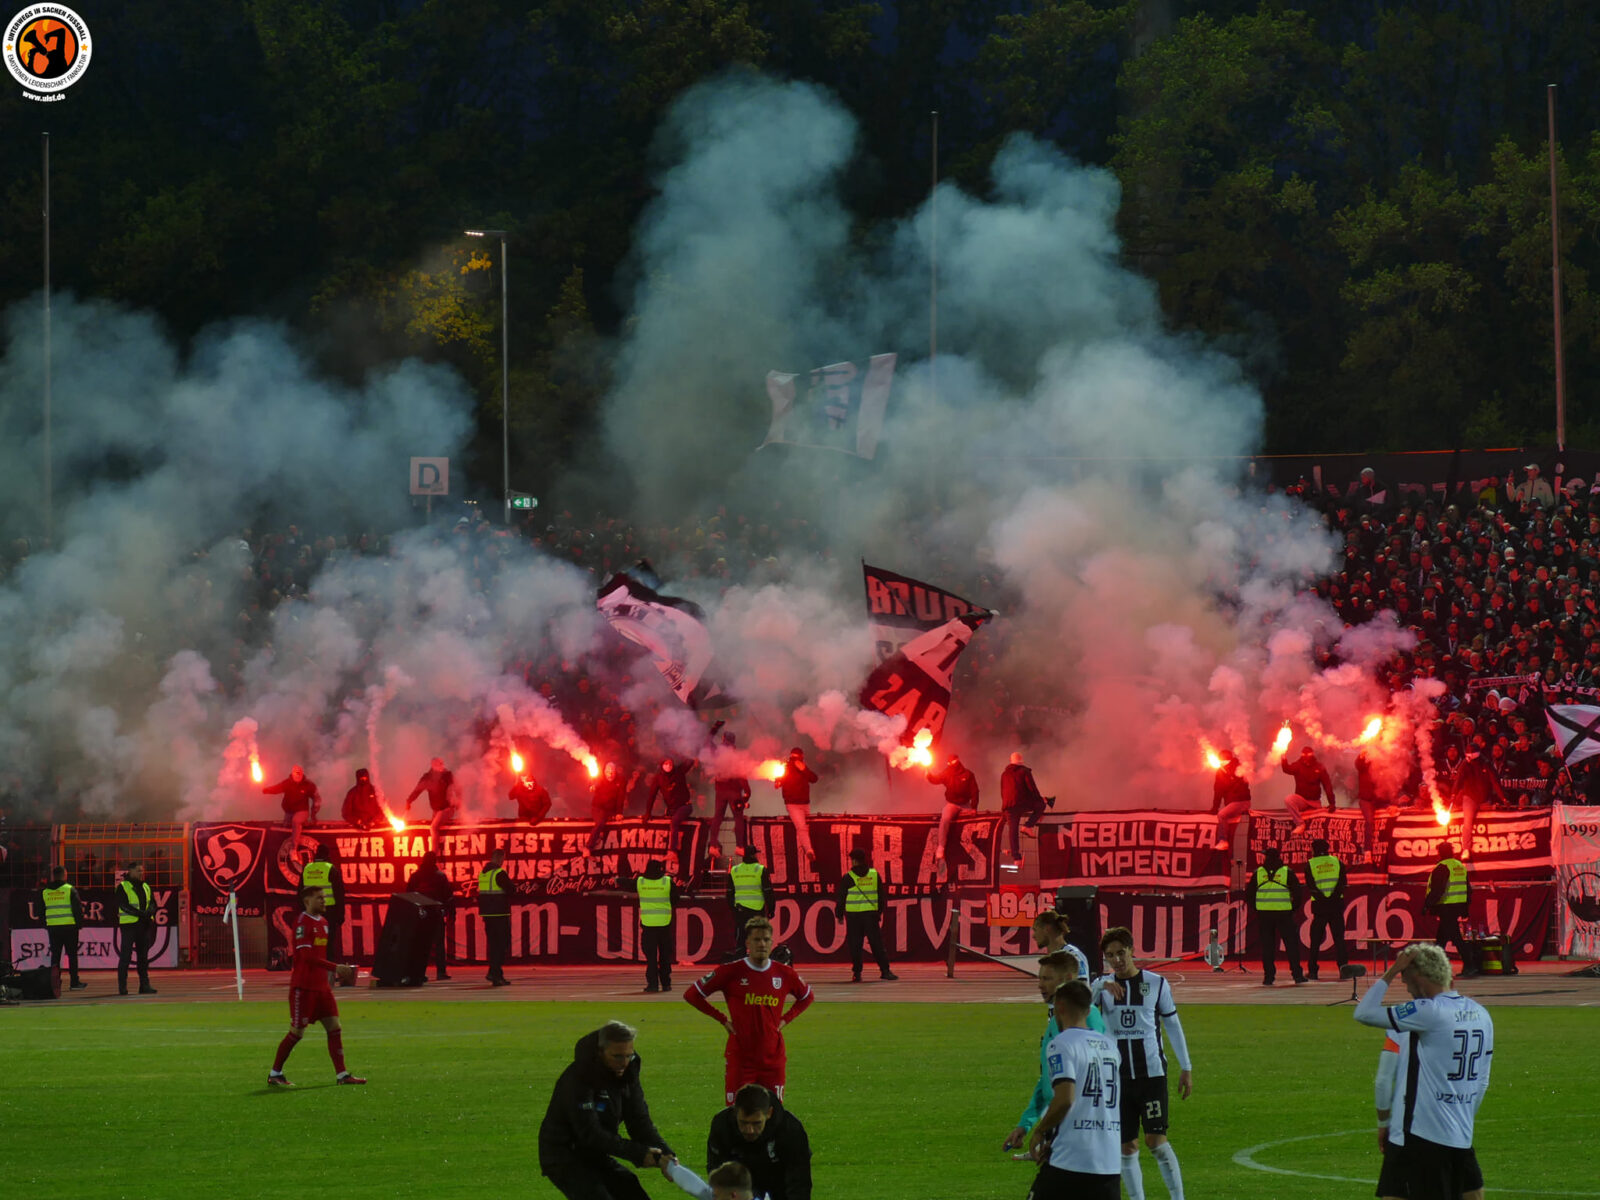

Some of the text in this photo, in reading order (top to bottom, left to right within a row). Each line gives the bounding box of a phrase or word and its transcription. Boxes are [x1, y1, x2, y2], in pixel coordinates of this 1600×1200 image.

[418, 463, 440, 489] D
[1057, 822, 1217, 850] NEBULOSA
[1562, 824, 1598, 837] 1999
[336, 837, 385, 857] WIR
[494, 833, 554, 854] FEST
[751, 822, 991, 886] ULTRAS
[341, 862, 395, 884] UND
[1081, 851, 1192, 877] IMPERO
[989, 892, 1055, 919] 1946
[744, 993, 779, 1007] Netto
[1447, 1029, 1485, 1081] 32
[1082, 1057, 1118, 1109] 43
[1146, 1100, 1162, 1119] 23
[1074, 1119, 1104, 1130] UZIN
